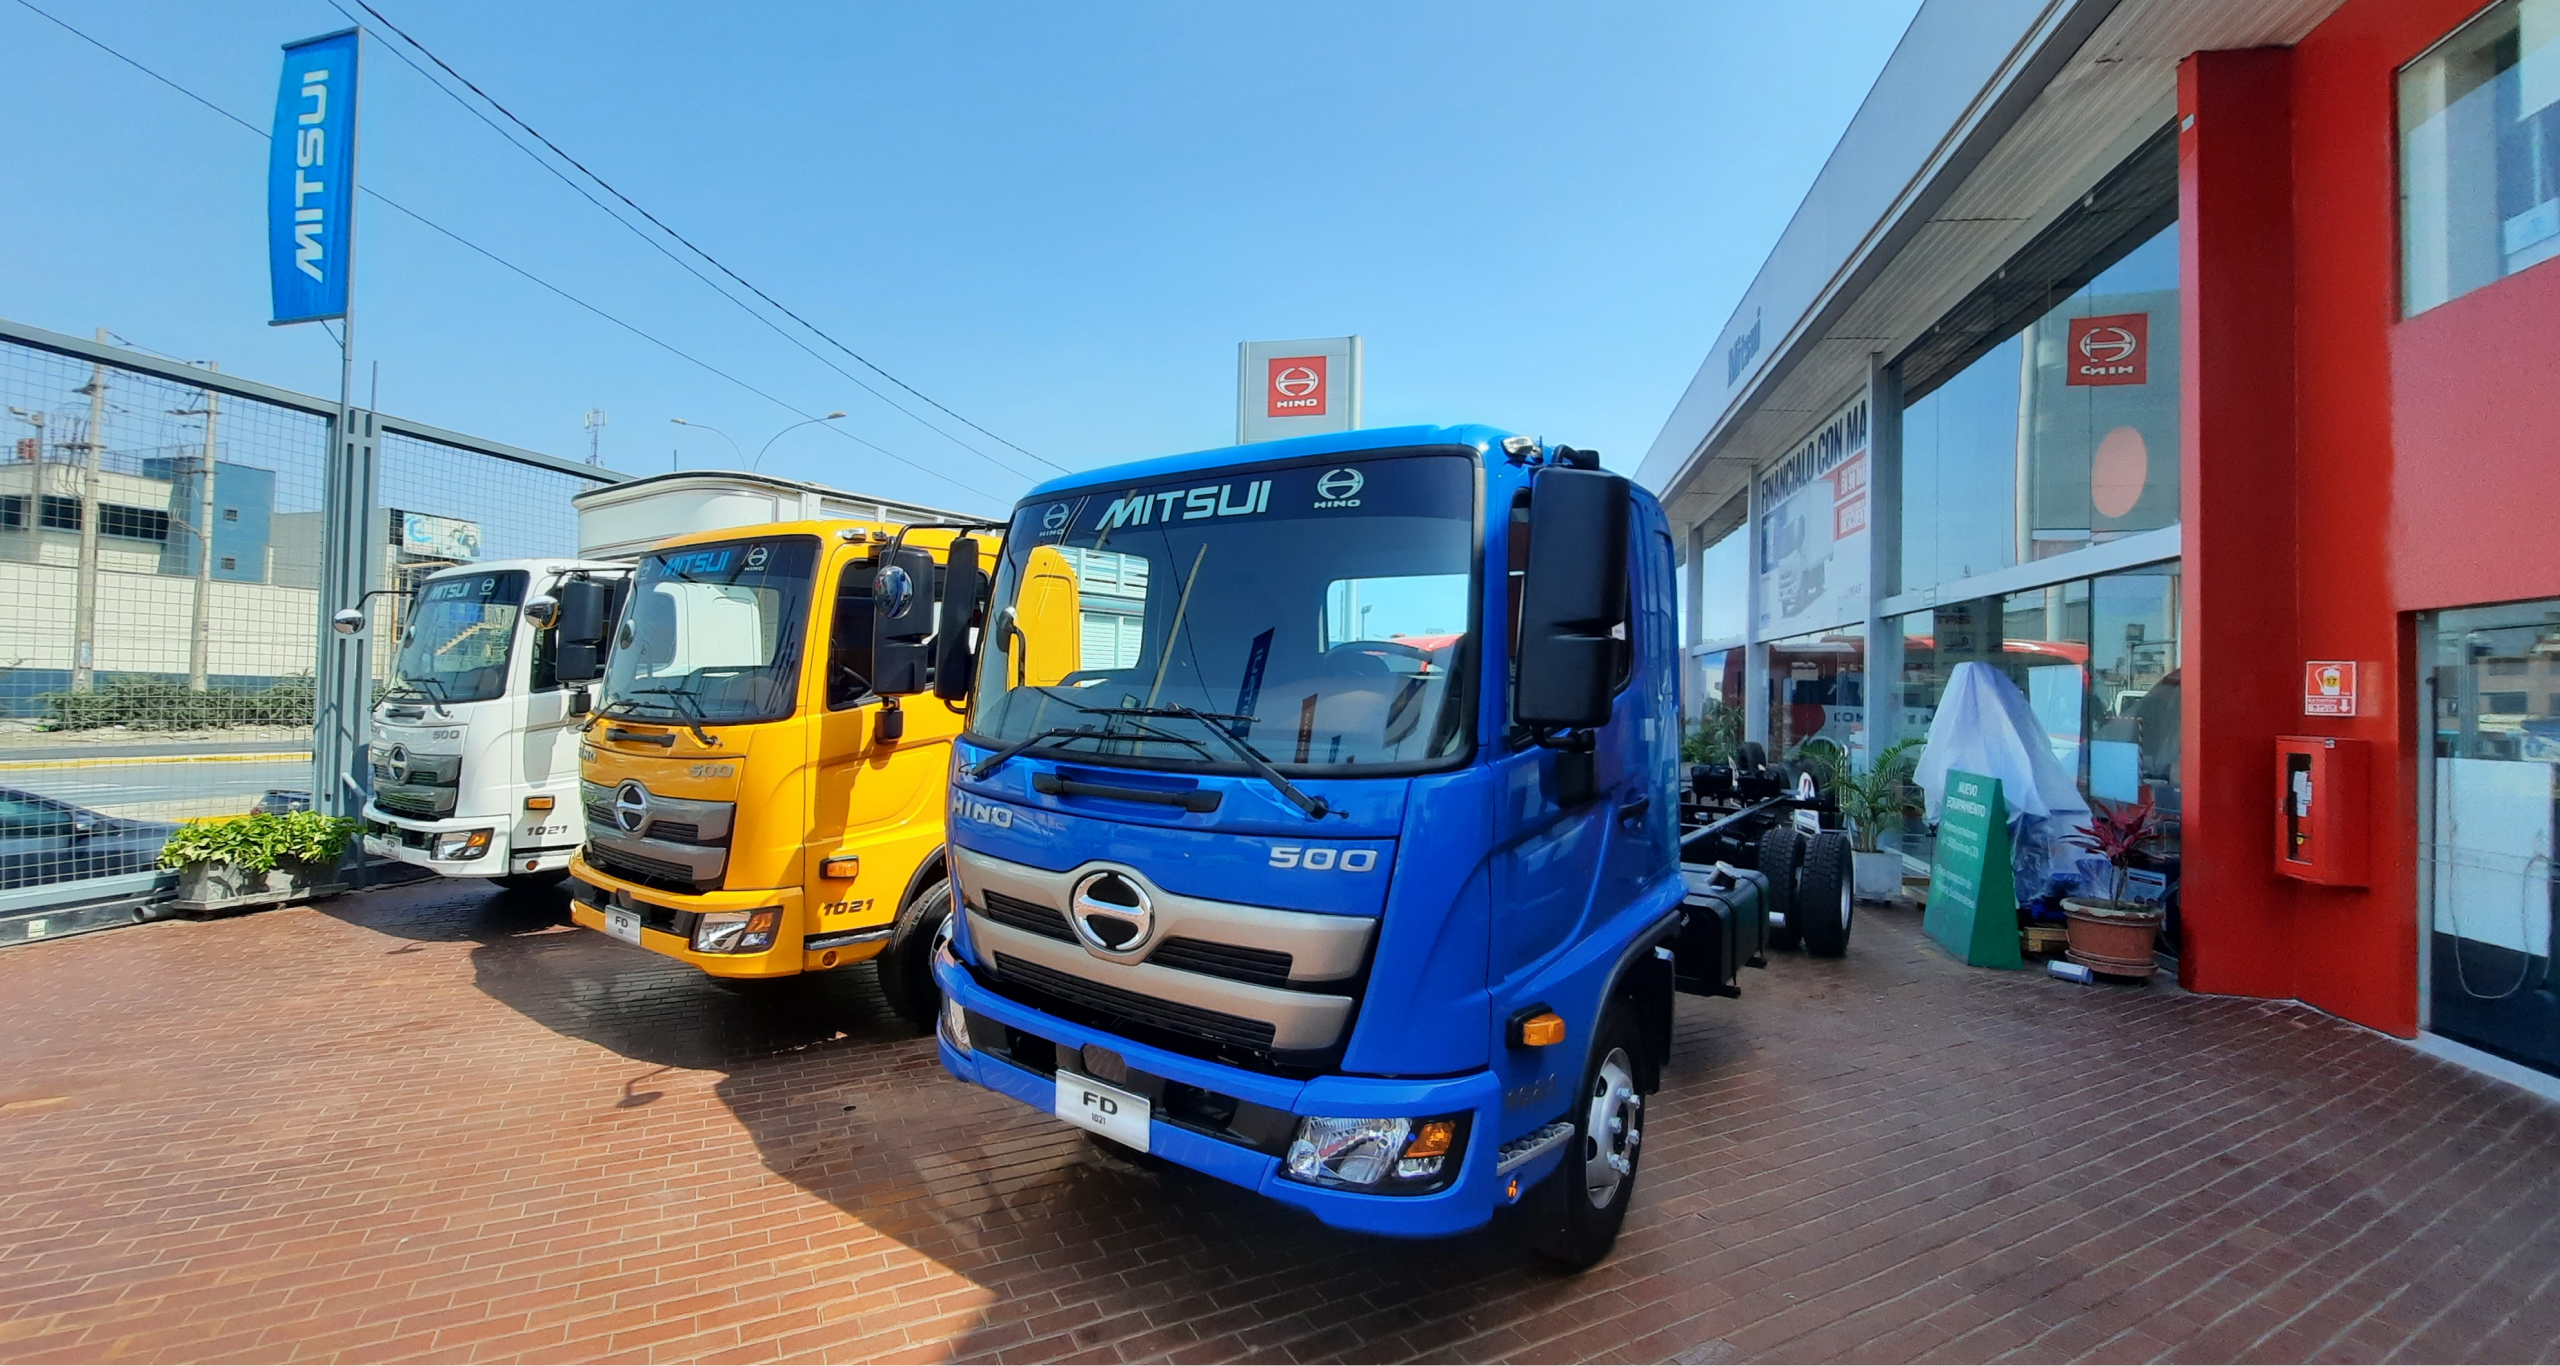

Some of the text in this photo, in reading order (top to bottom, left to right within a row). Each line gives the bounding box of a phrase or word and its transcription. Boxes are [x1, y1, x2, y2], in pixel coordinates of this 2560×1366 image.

[295, 69, 329, 283] MITSUI
[1276, 399, 1318, 408] HINO
[1817, 418, 1843, 475] CON
[1095, 480, 1273, 531] MITSUI
[1314, 499, 1361, 509] HINO
[1039, 528, 1065, 537] HINO
[659, 551, 731, 577] MITSUI
[428, 582, 471, 600] MITSUI
[433, 730, 460, 739] 500
[690, 764, 734, 777] 500
[1957, 781, 1979, 797] NUEVO
[952, 796, 1013, 828] HINO
[526, 825, 568, 836] 1021
[1269, 846, 1378, 872] 500
[823, 897, 875, 917] 1021
[615, 916, 629, 928] FD
[1083, 1091, 1118, 1115] FD
[1091, 1112, 1106, 1125] 1021
